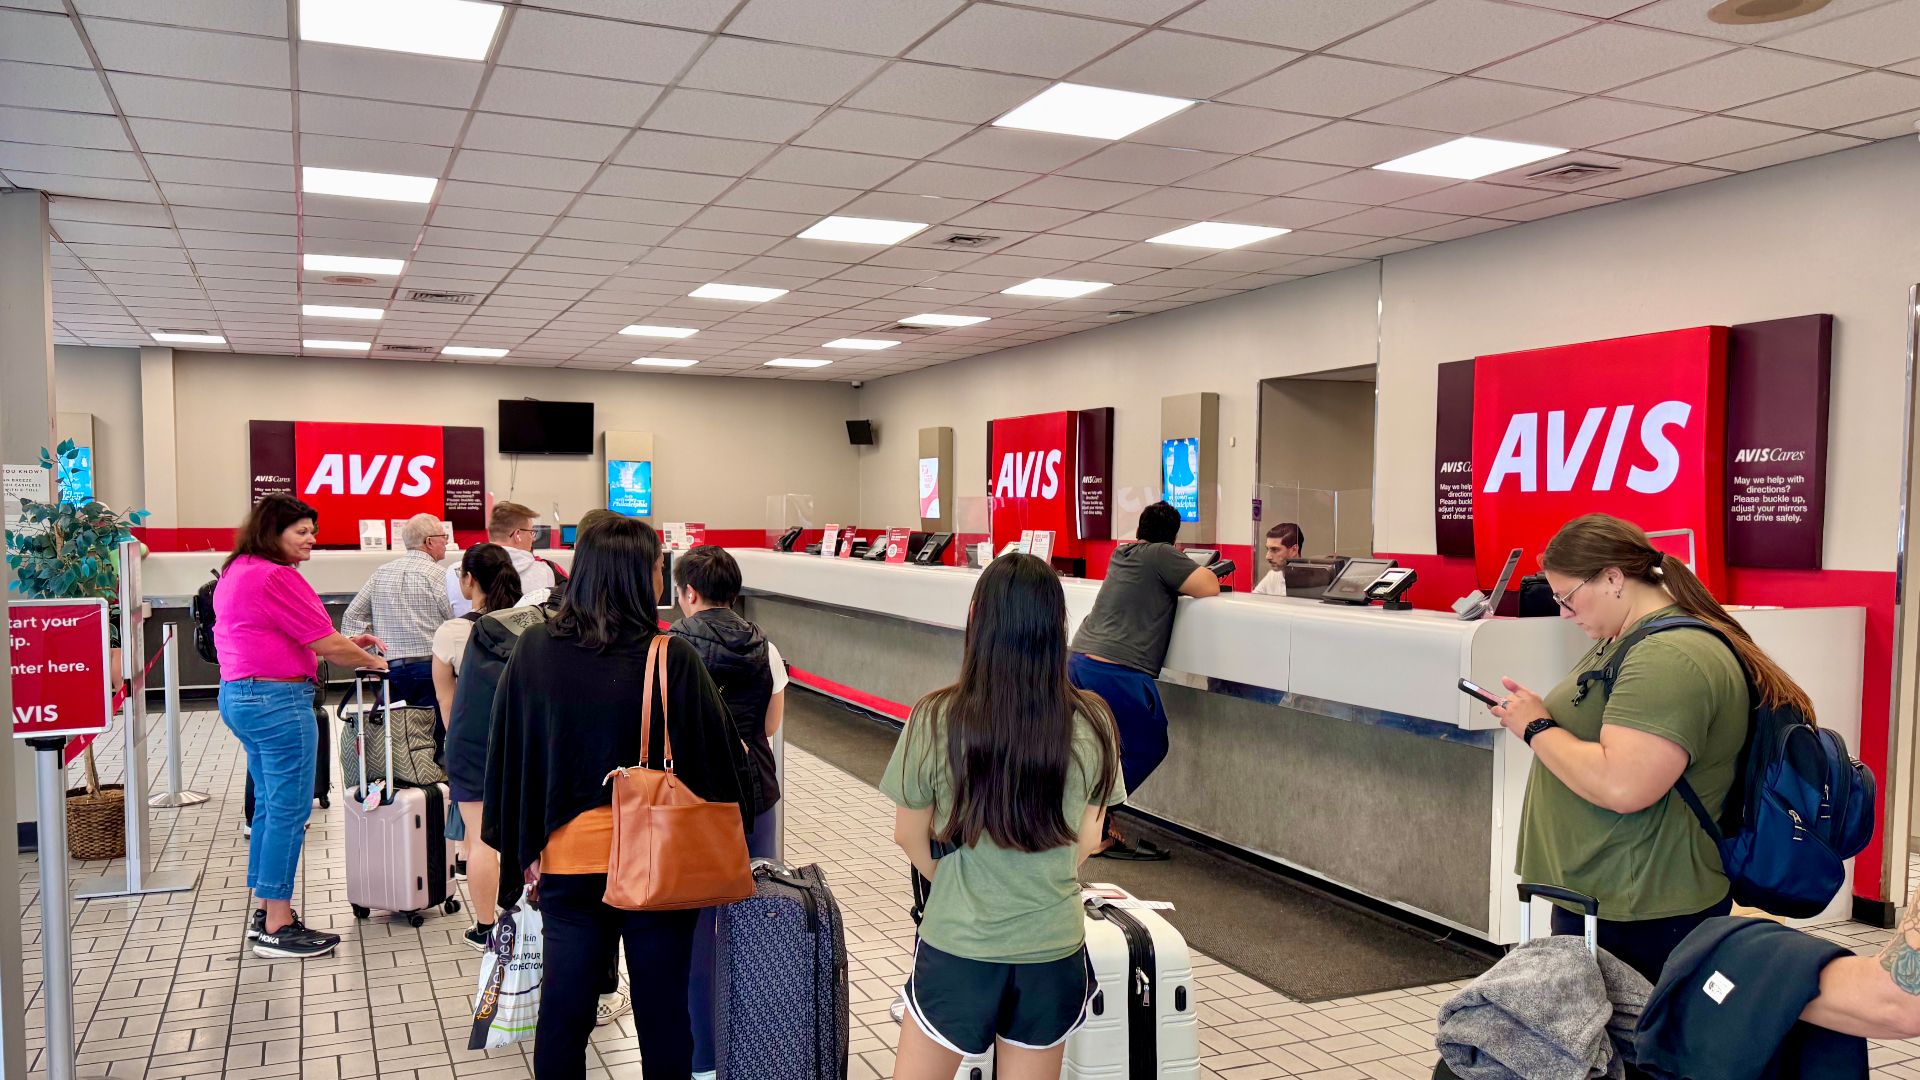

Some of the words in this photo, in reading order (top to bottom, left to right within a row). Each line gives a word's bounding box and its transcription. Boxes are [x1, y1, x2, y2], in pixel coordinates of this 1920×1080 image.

[1482, 400, 1692, 494] AVIS
[304, 454, 436, 497] AVIS
[995, 449, 1062, 500] AVIS
[1734, 476, 1750, 485] May
[1767, 476, 1784, 484] help
[1747, 485, 1790, 493] directions?
[1731, 504, 1754, 513] adjust
[1778, 504, 1807, 512] mirrors
[1776, 514, 1802, 523] safely.
[8, 616, 37, 628] tart
[42, 618, 78, 631] your
[10, 635, 30, 650] ip.
[10, 663, 43, 674] nter
[48, 660, 90, 673] here.
[258, 932, 280, 944] HOKA
